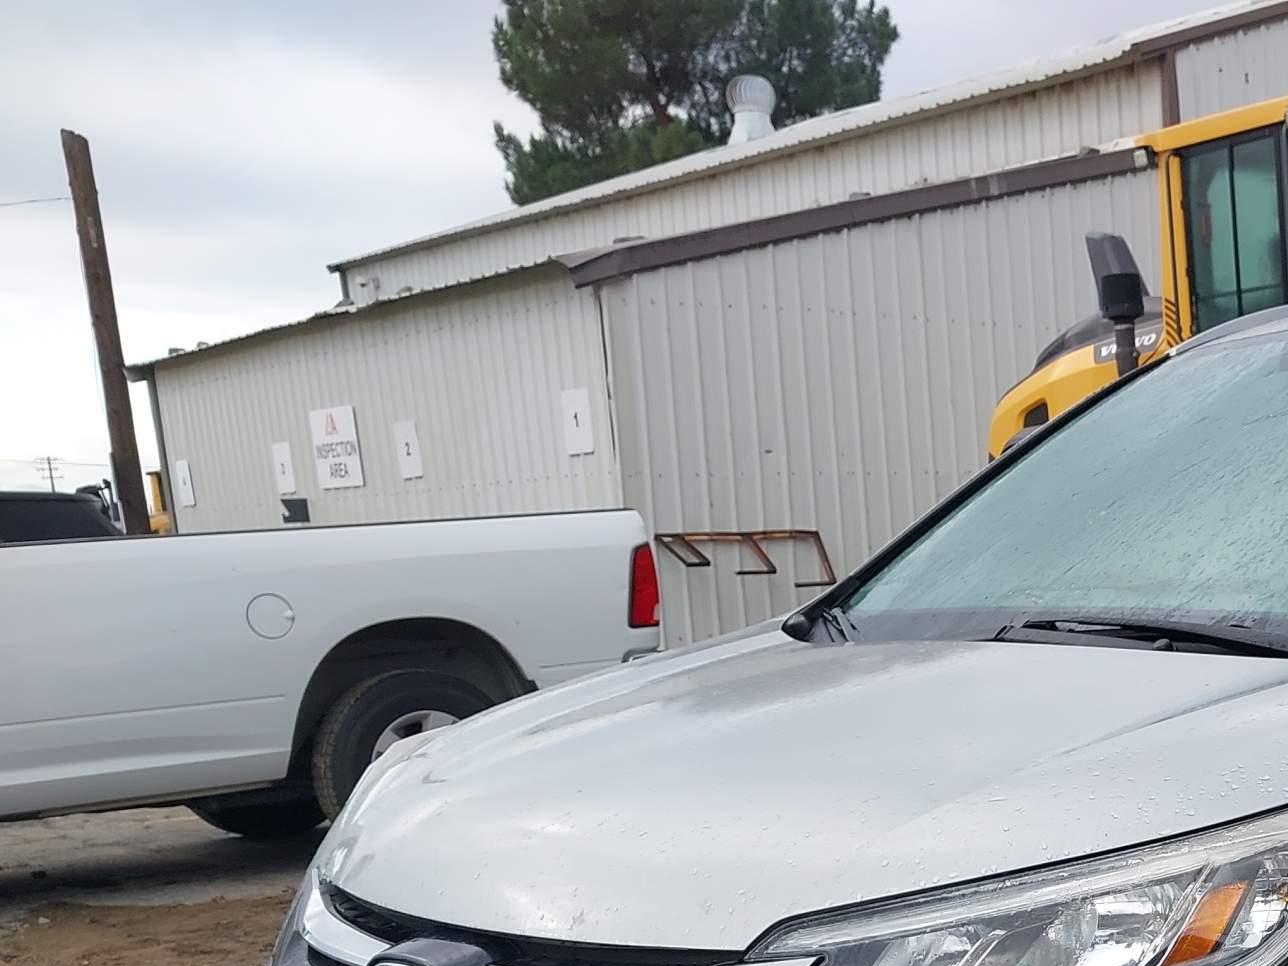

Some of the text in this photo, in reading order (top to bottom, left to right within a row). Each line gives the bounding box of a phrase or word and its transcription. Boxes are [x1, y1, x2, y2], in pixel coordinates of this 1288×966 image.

[573, 411, 579, 428] 1
[315, 440, 357, 459] INSPECTION
[404, 441, 412, 457] 2
[329, 461, 350, 479] AREA
